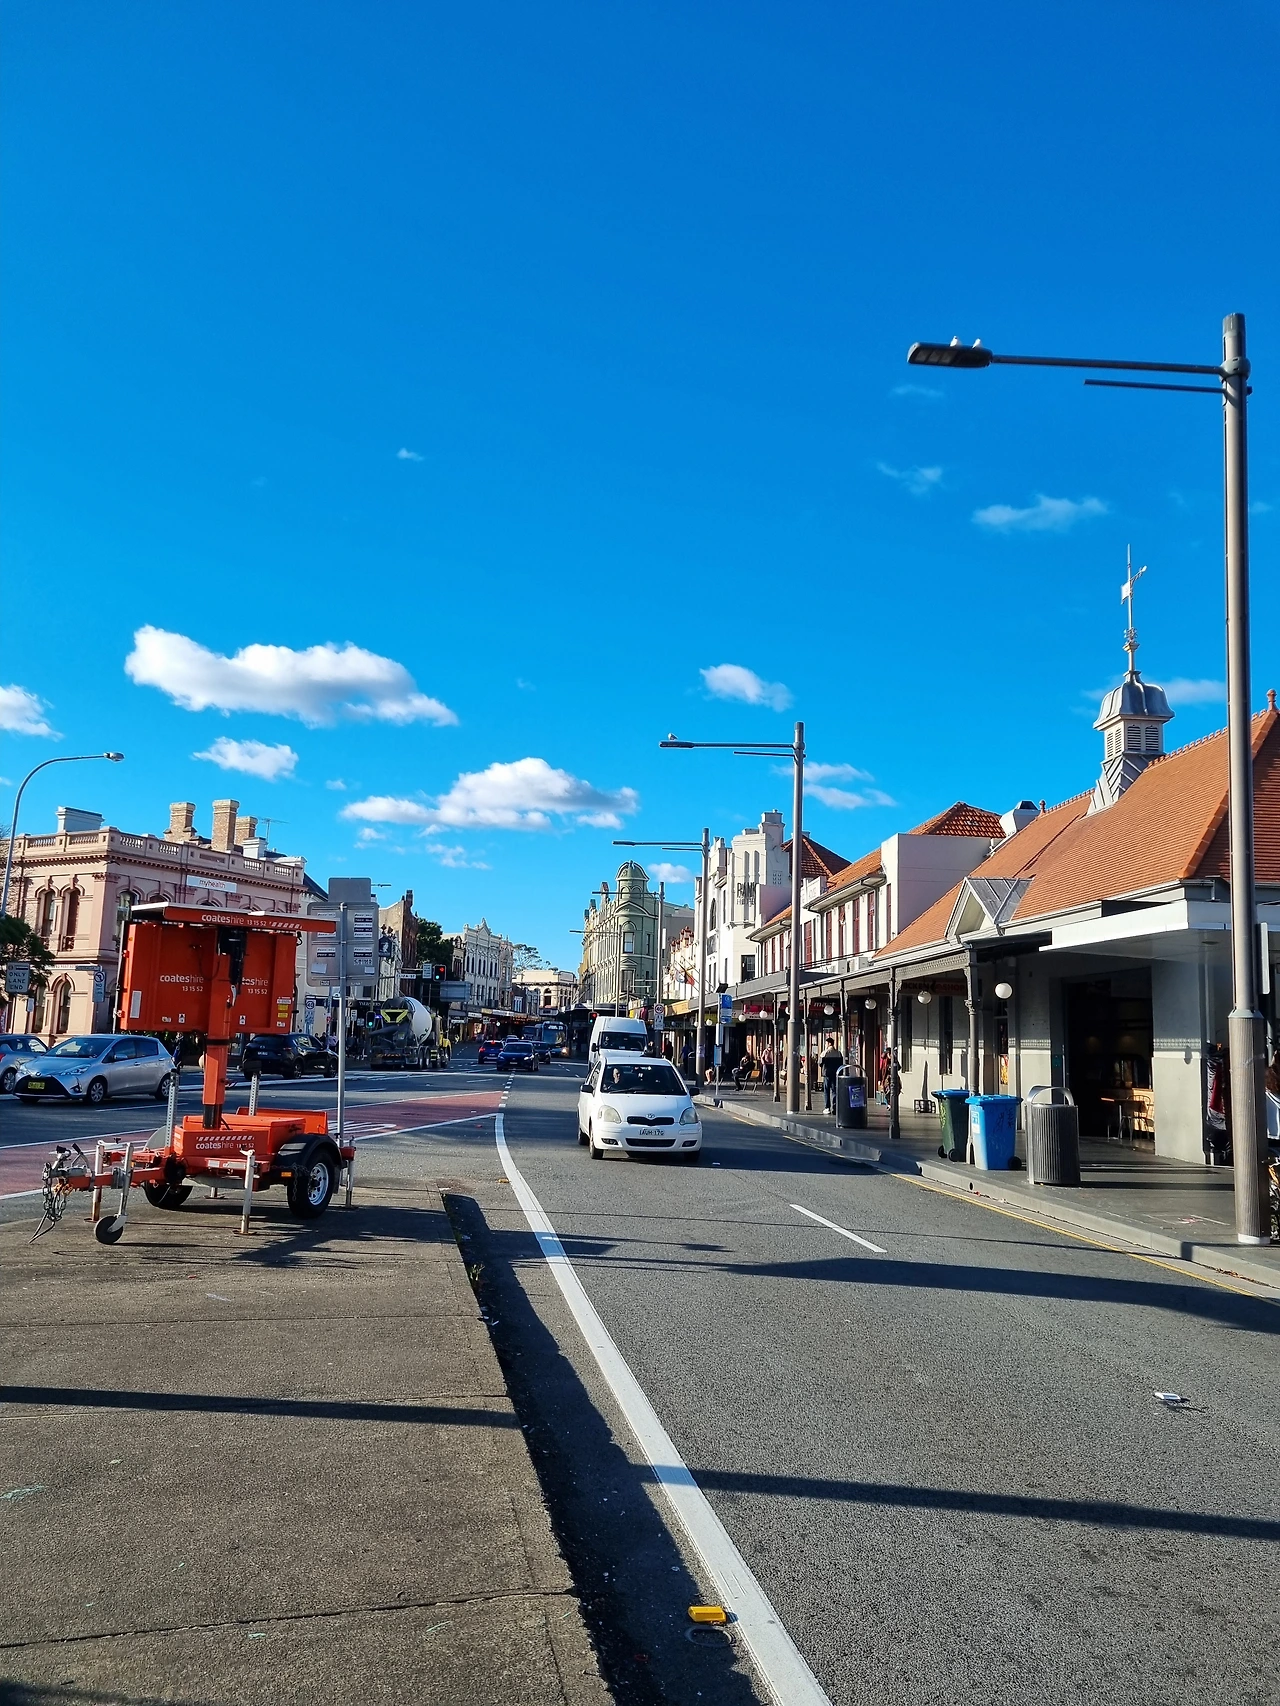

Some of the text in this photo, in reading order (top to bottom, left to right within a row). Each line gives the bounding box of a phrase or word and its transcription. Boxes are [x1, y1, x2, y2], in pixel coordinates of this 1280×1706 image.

[199, 879, 226, 889] myhealth
[201, 913, 245, 925] coateshire
[160, 974, 204, 983] coateshire
